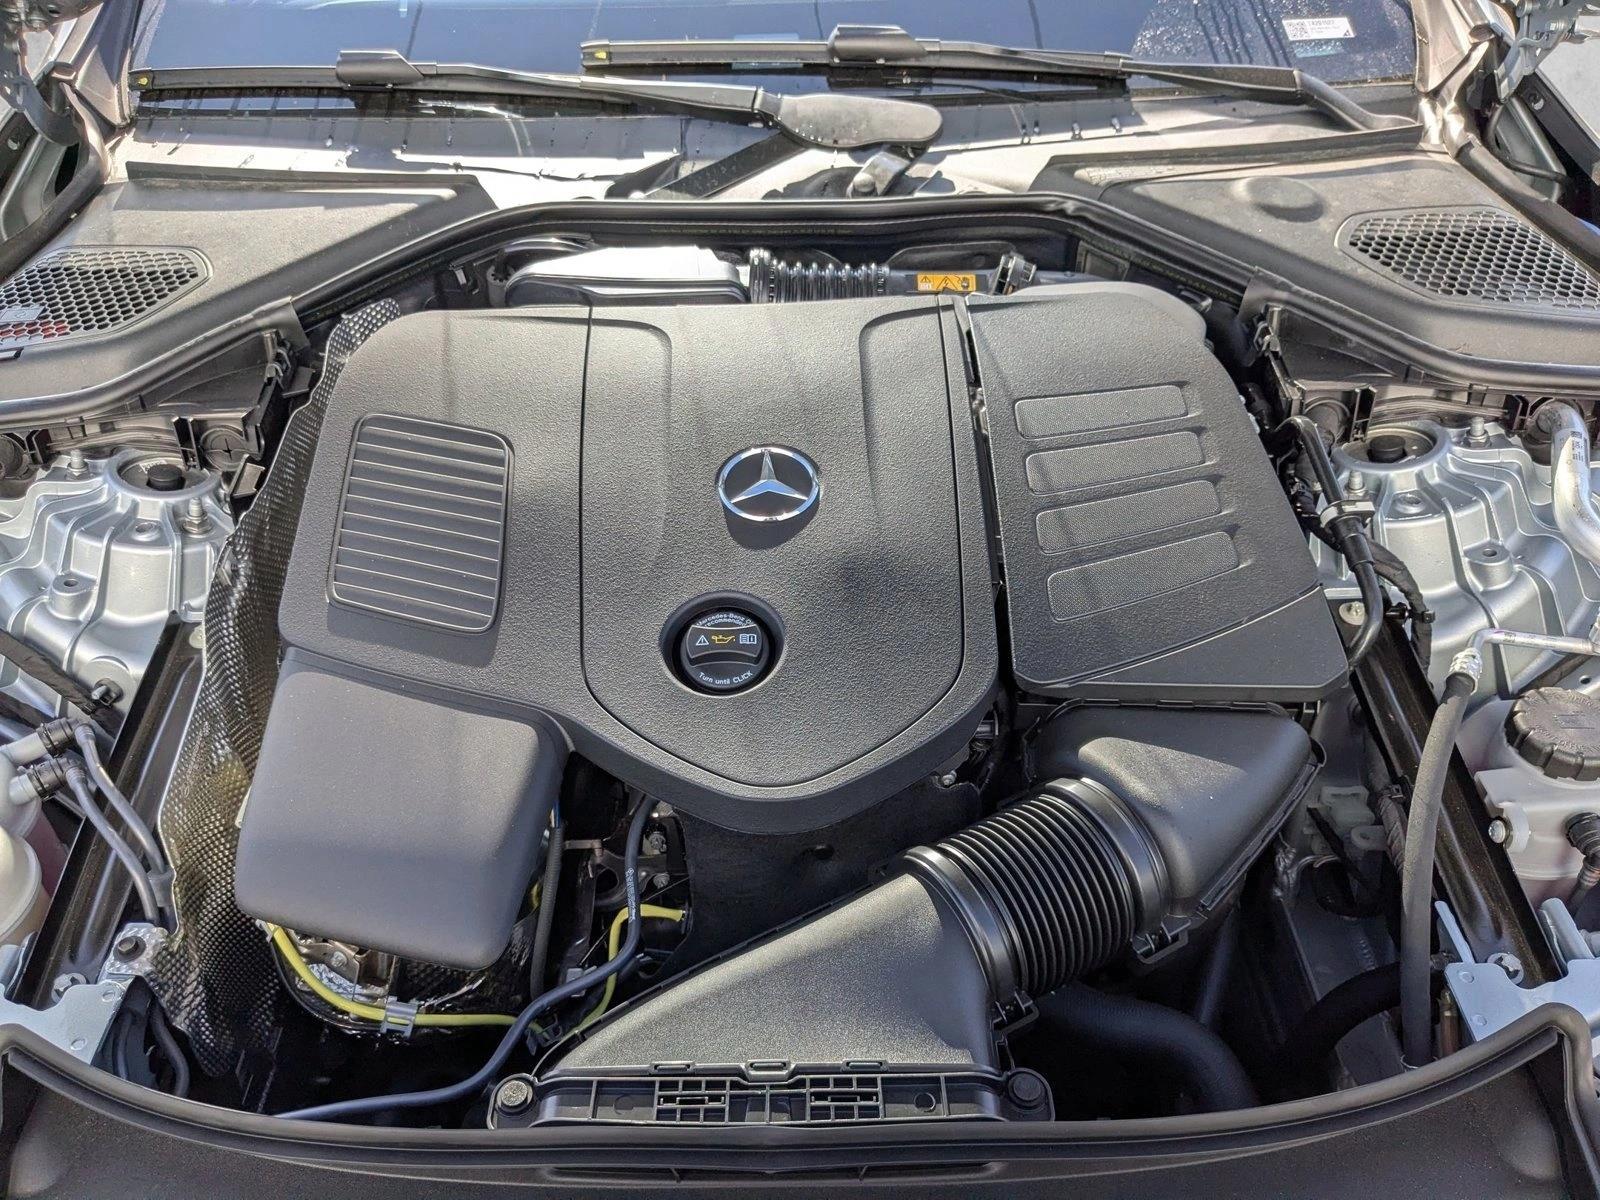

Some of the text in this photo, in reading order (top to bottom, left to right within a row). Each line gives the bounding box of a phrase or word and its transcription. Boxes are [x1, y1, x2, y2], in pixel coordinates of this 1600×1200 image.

[696, 613, 745, 626] Mercedes-Benz
[699, 671, 713, 683] Turn
[732, 670, 753, 683] CLICK
